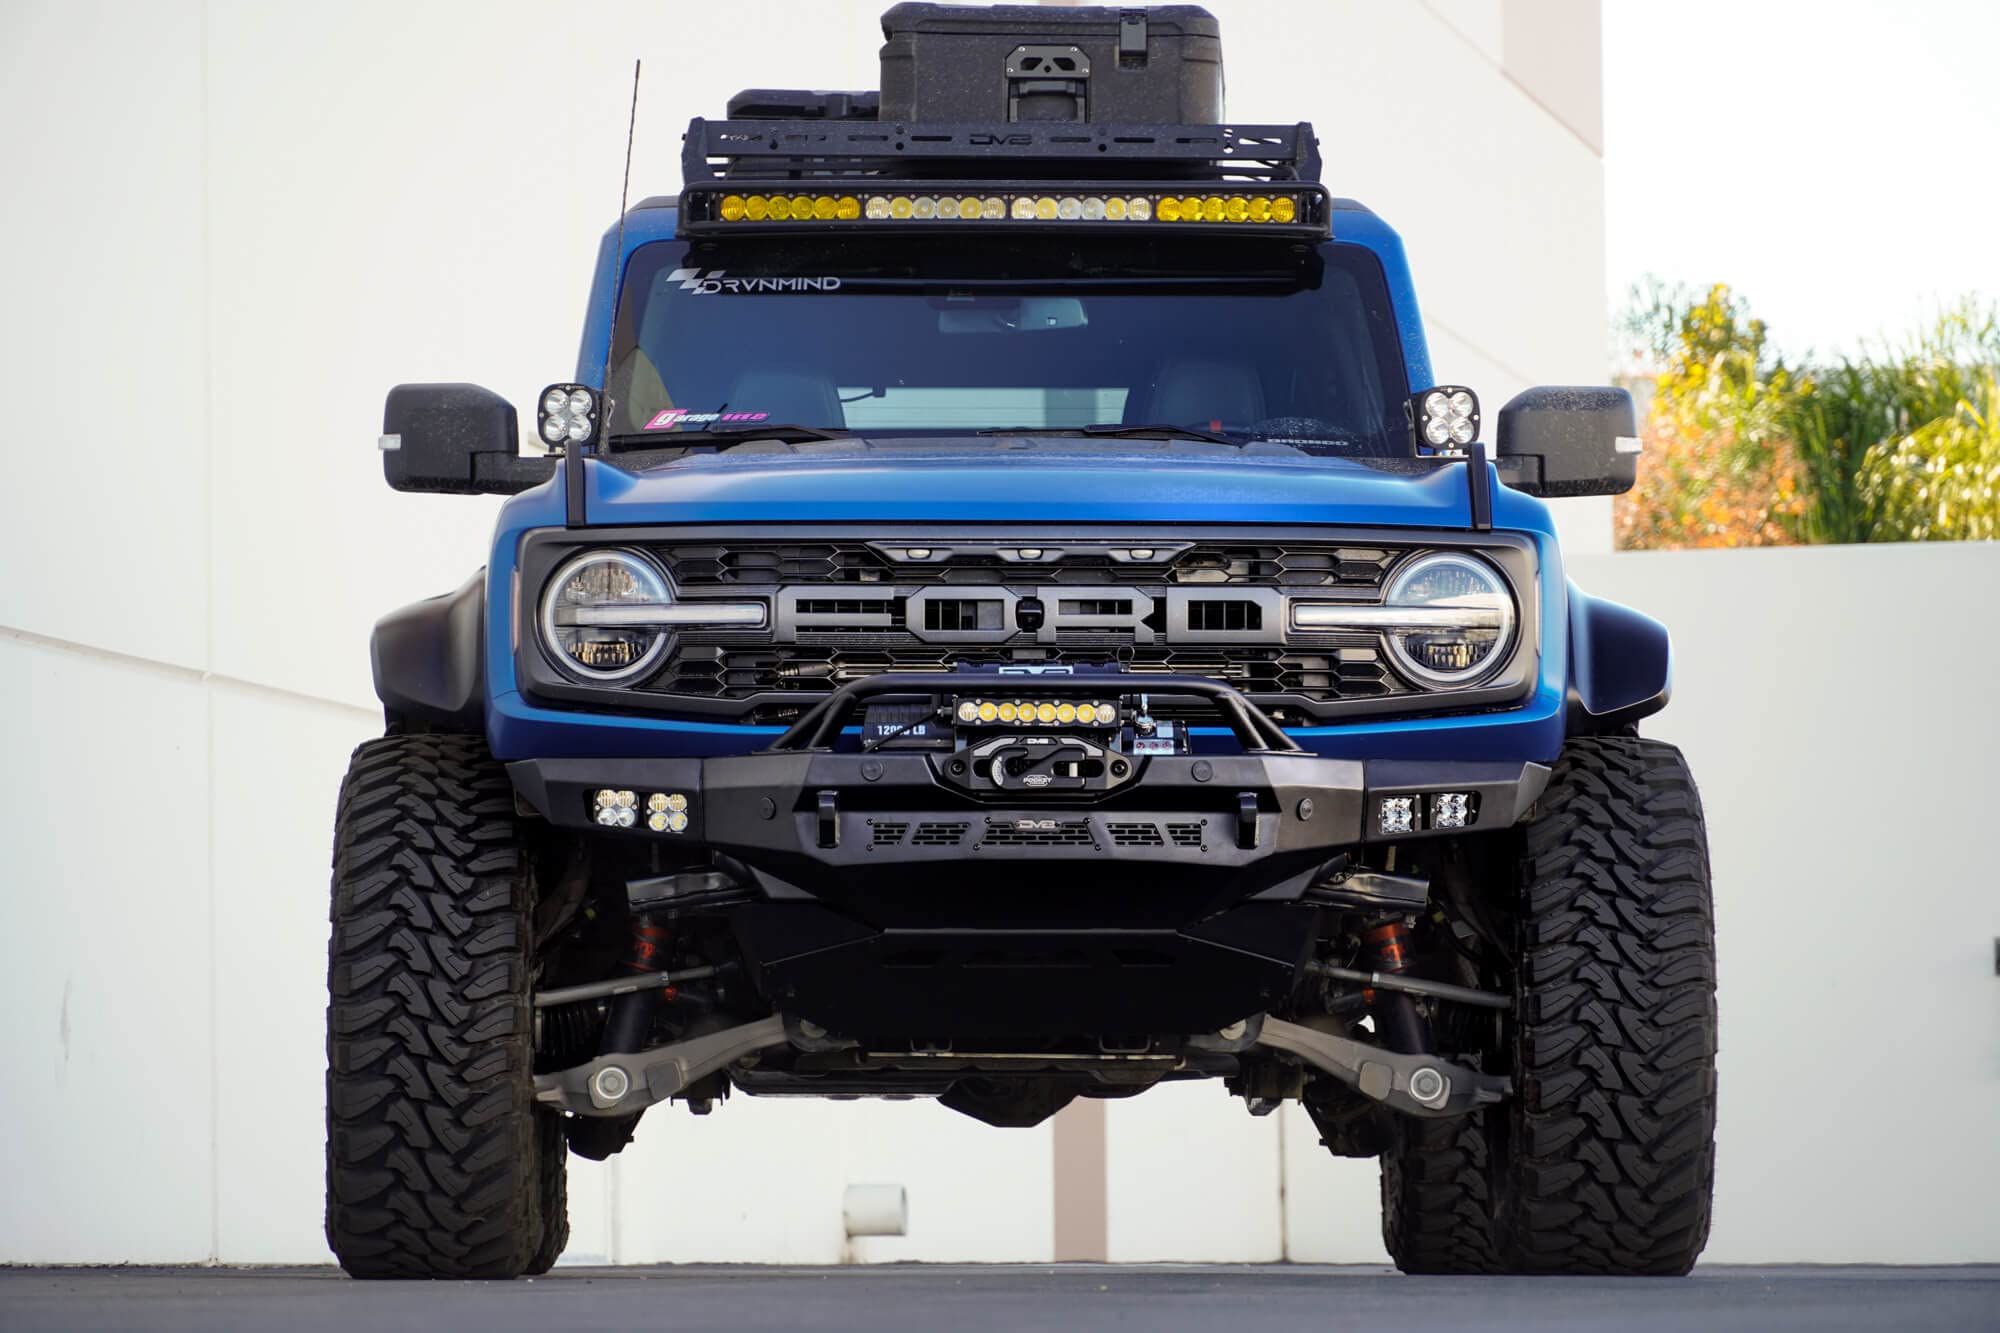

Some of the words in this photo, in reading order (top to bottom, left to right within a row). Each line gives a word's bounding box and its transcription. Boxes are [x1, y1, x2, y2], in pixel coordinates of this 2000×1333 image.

[702, 277, 841, 294] DRVNMIND
[775, 585, 1286, 643] FORD
[913, 725, 926, 735] LB
[1019, 820, 1056, 829] DV8
